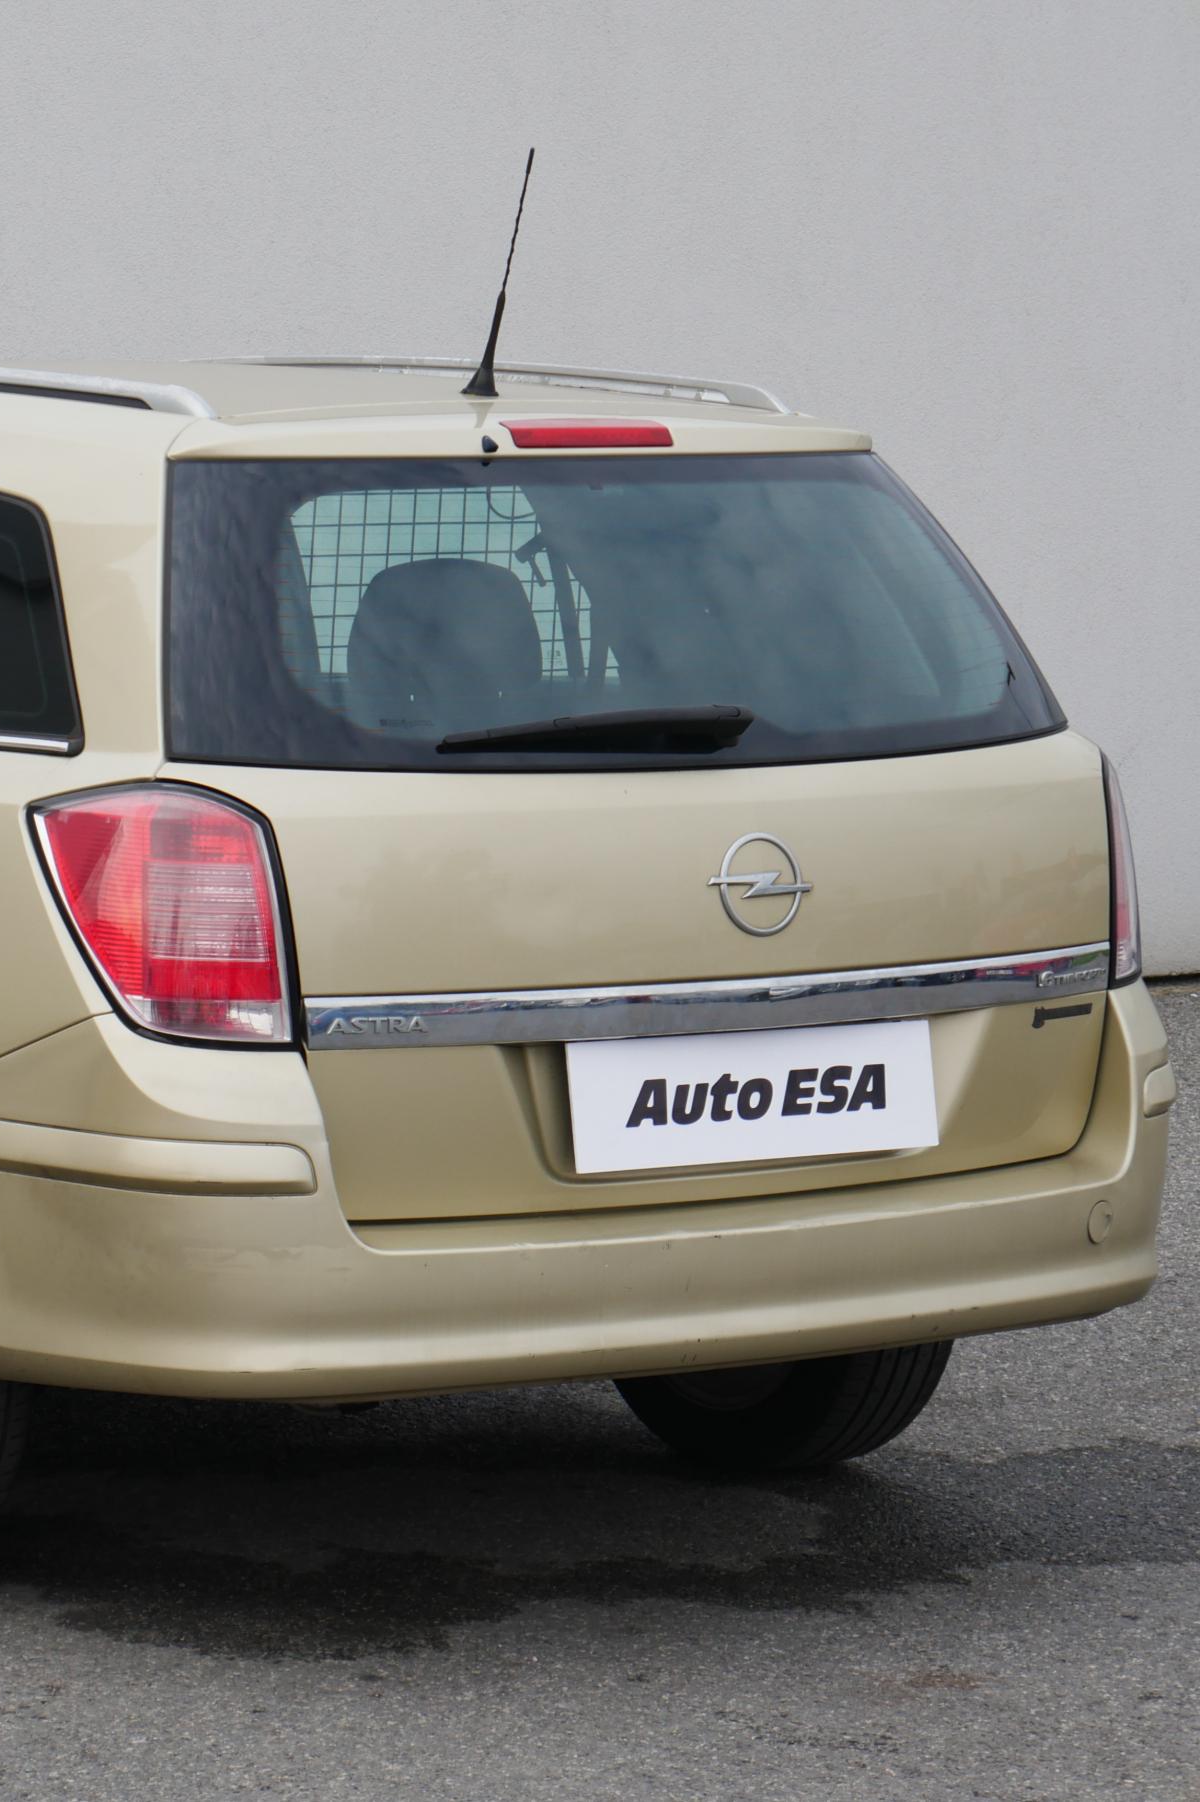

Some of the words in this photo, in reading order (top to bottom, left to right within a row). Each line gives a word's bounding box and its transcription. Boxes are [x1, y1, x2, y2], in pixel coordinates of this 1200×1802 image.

[327, 1015, 428, 1035] ASTRA
[625, 1073, 773, 1128] Auto
[781, 1063, 886, 1117] ESA
